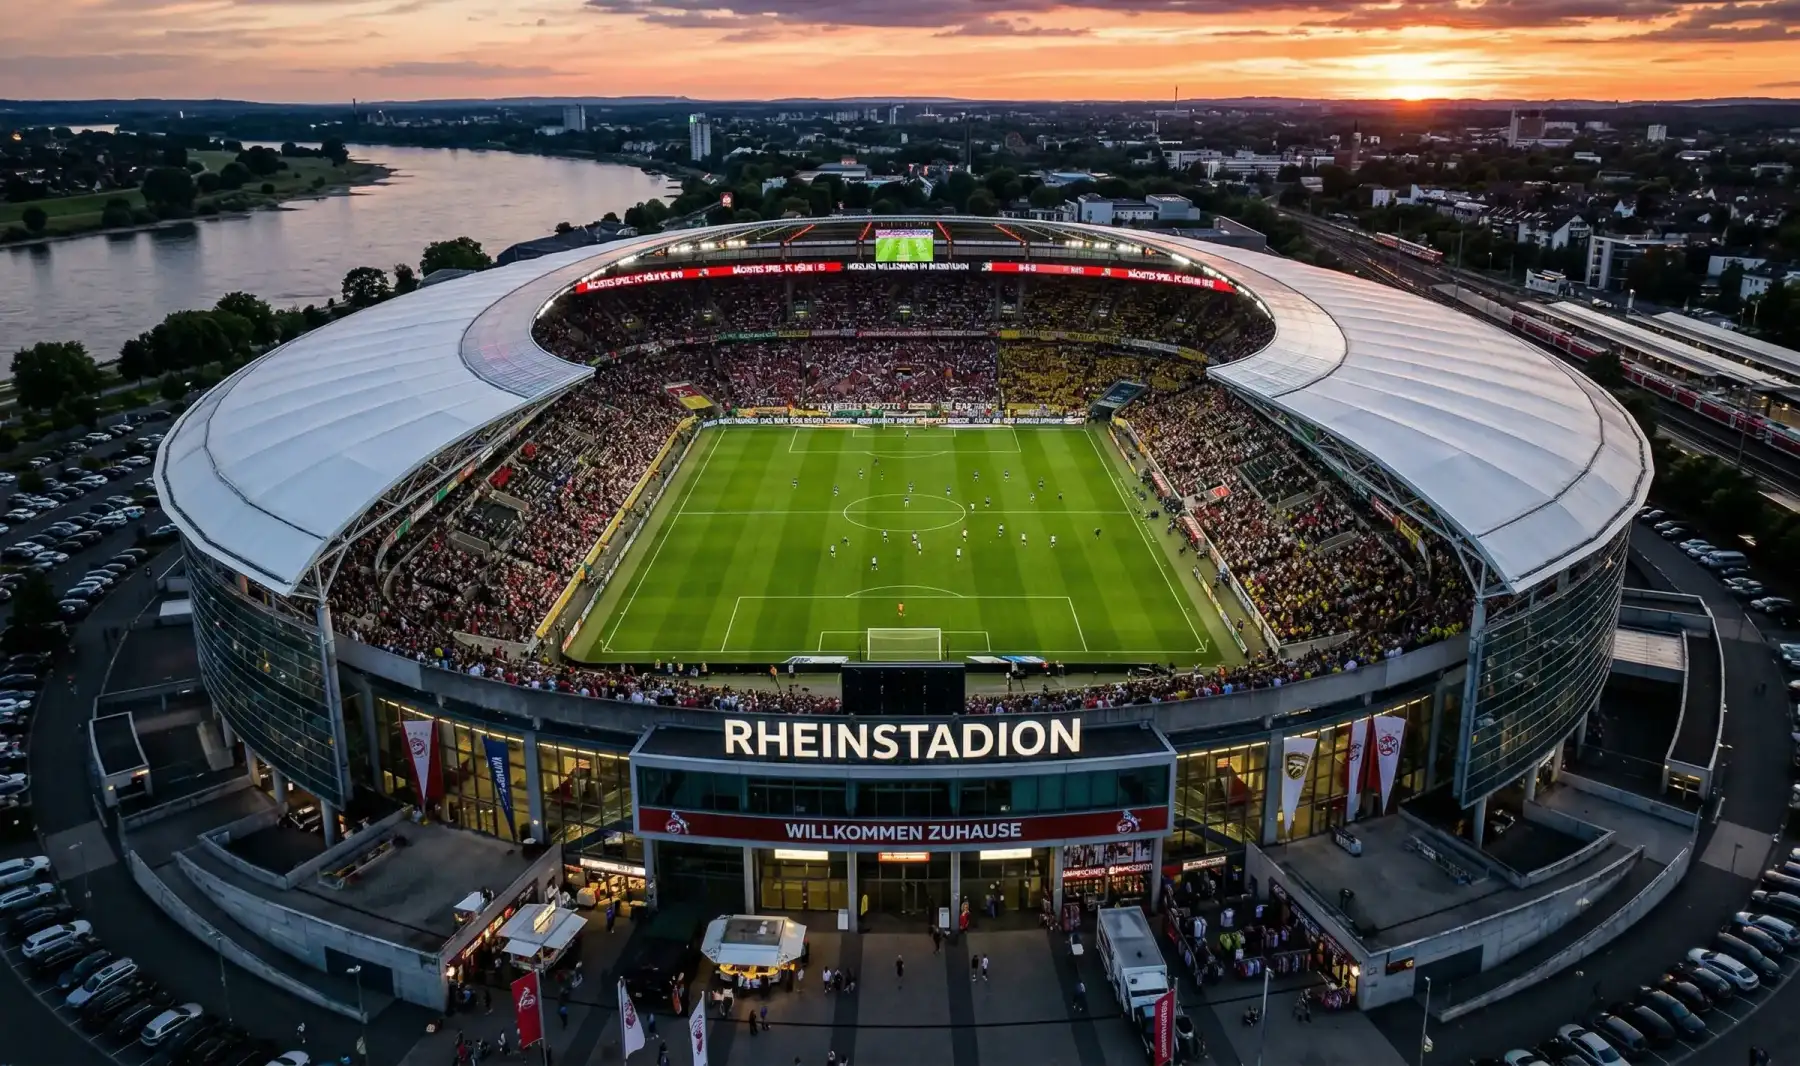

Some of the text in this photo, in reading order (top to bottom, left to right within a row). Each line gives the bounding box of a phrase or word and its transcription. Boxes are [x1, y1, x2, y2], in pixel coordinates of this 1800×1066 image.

[725, 717, 1081, 759] RHEINSTADION
[785, 822, 1022, 841] WILLKOMMEN ZUHAUSE
